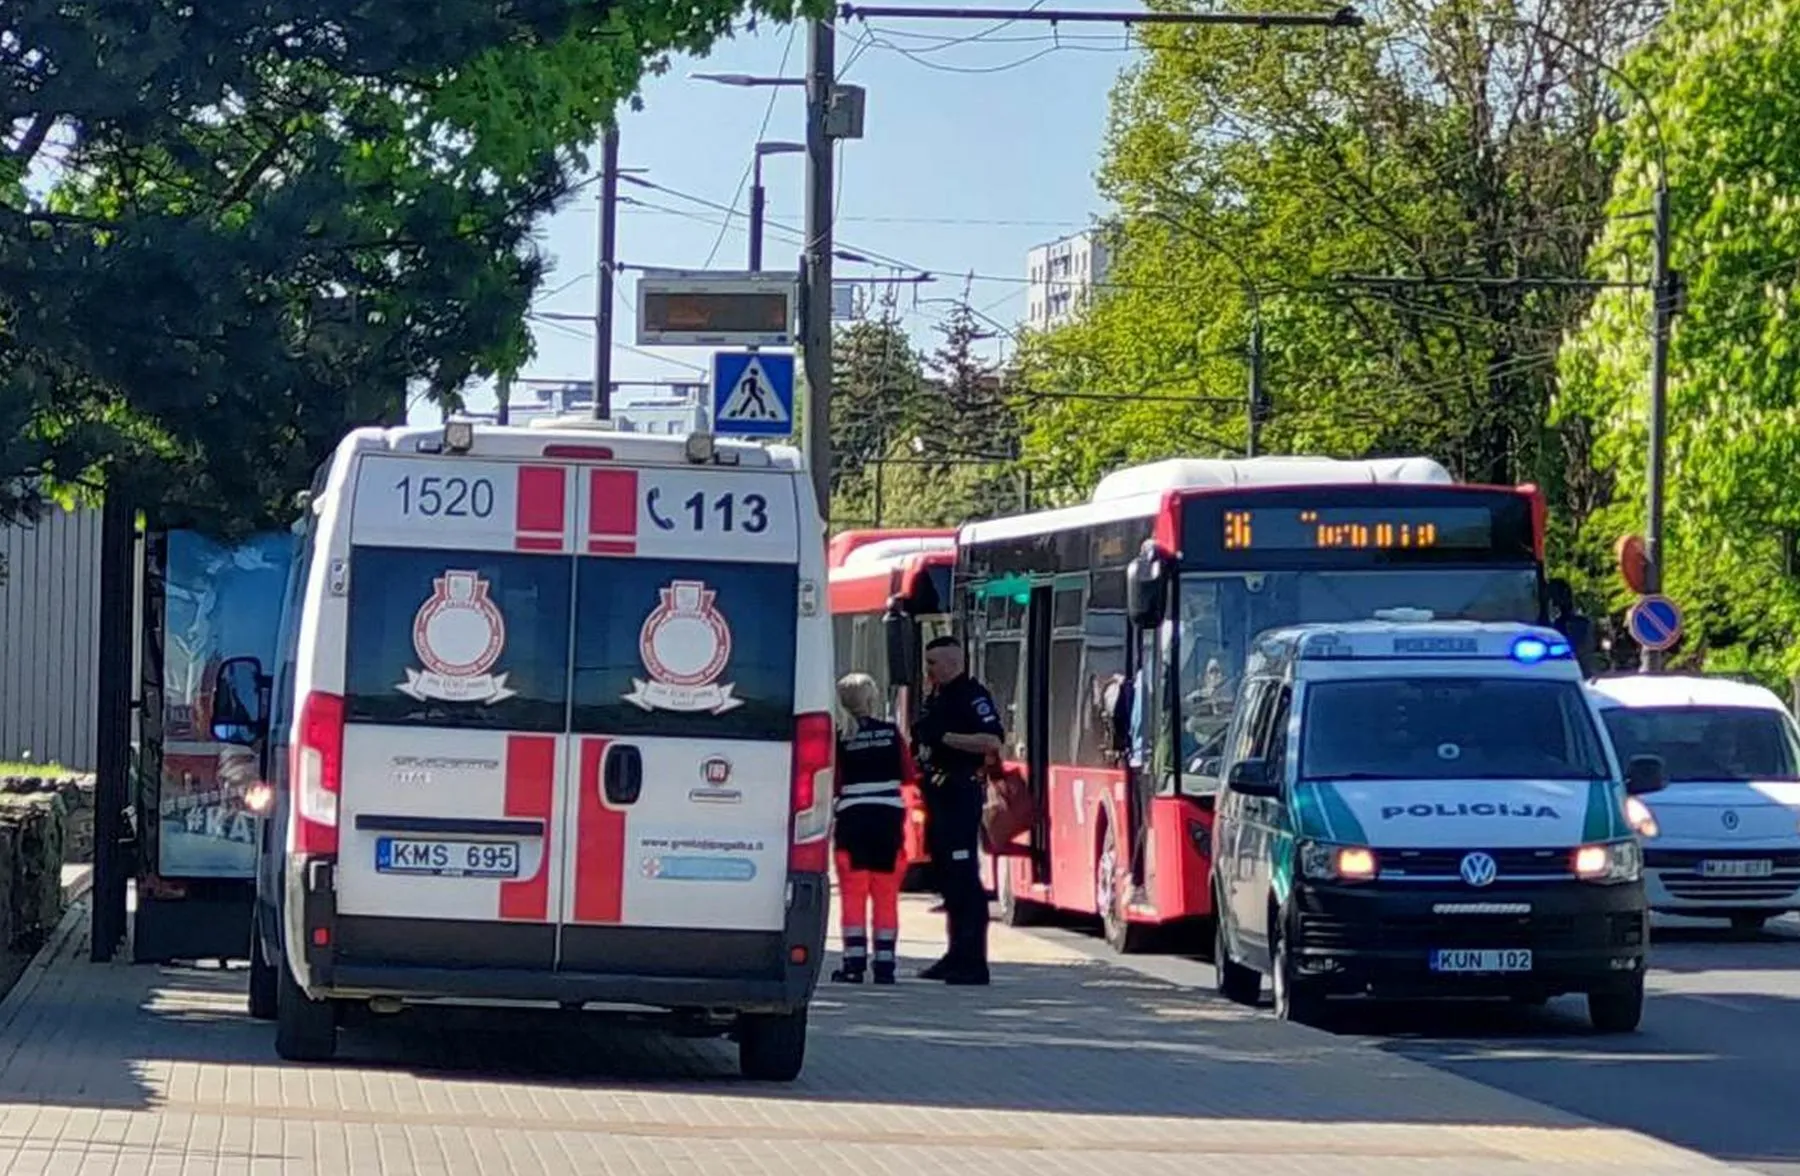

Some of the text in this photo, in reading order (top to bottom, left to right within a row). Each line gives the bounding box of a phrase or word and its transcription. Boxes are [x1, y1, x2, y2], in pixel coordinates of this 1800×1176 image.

[394, 475, 494, 518] 1520
[684, 490, 769, 533] 113
[1380, 802, 1561, 820] POLICIJA
[393, 843, 449, 867] KMS
[466, 845, 513, 869] 695
[1440, 951, 1530, 969] KUN 102
